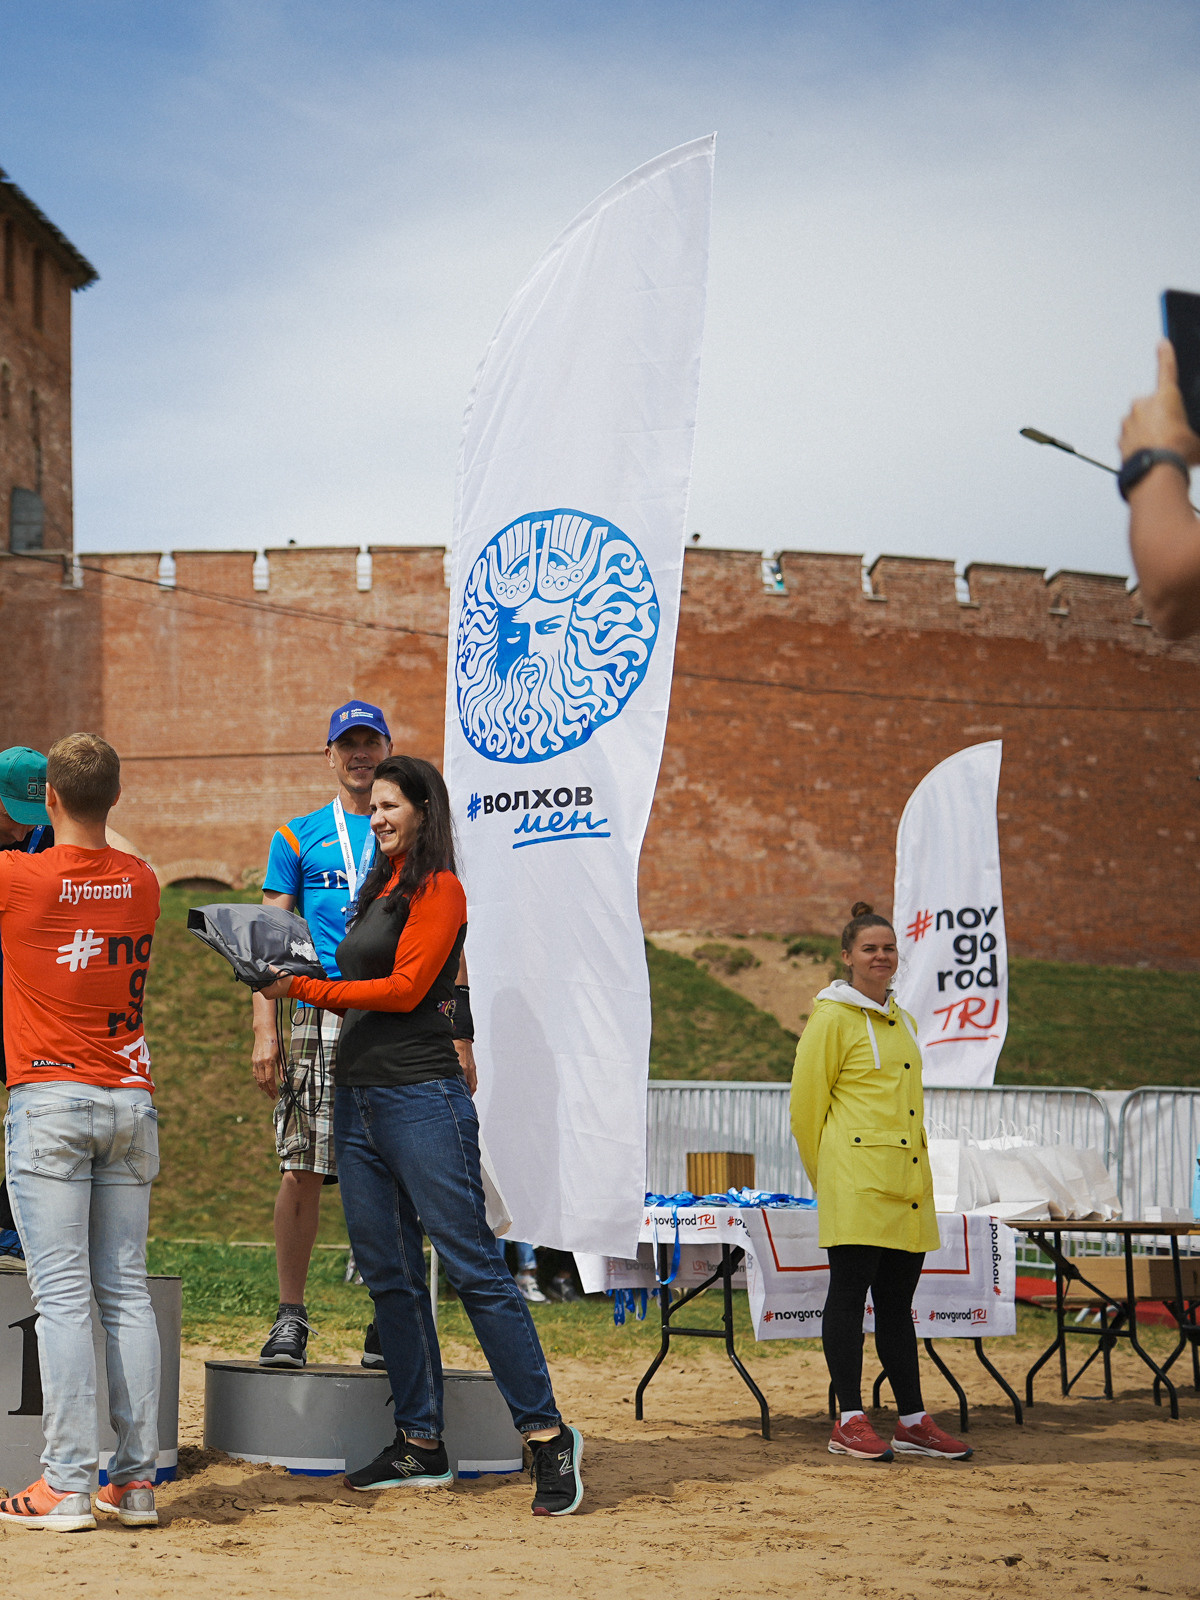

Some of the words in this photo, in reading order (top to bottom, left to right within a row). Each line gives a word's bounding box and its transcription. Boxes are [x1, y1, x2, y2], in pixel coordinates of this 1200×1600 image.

[514, 810, 608, 834] мен
[58, 877, 132, 905] Дубовой
[906, 906, 998, 942] #nov
[56, 929, 153, 972] #no
[953, 932, 997, 965] go
[129, 969, 148, 1003] g
[937, 954, 998, 992] rod
[107, 1006, 142, 1036] ro
[933, 997, 999, 1031] TRI
[763, 1310, 823, 1322] #novgoro
[8, 1313, 42, 1416] 1
